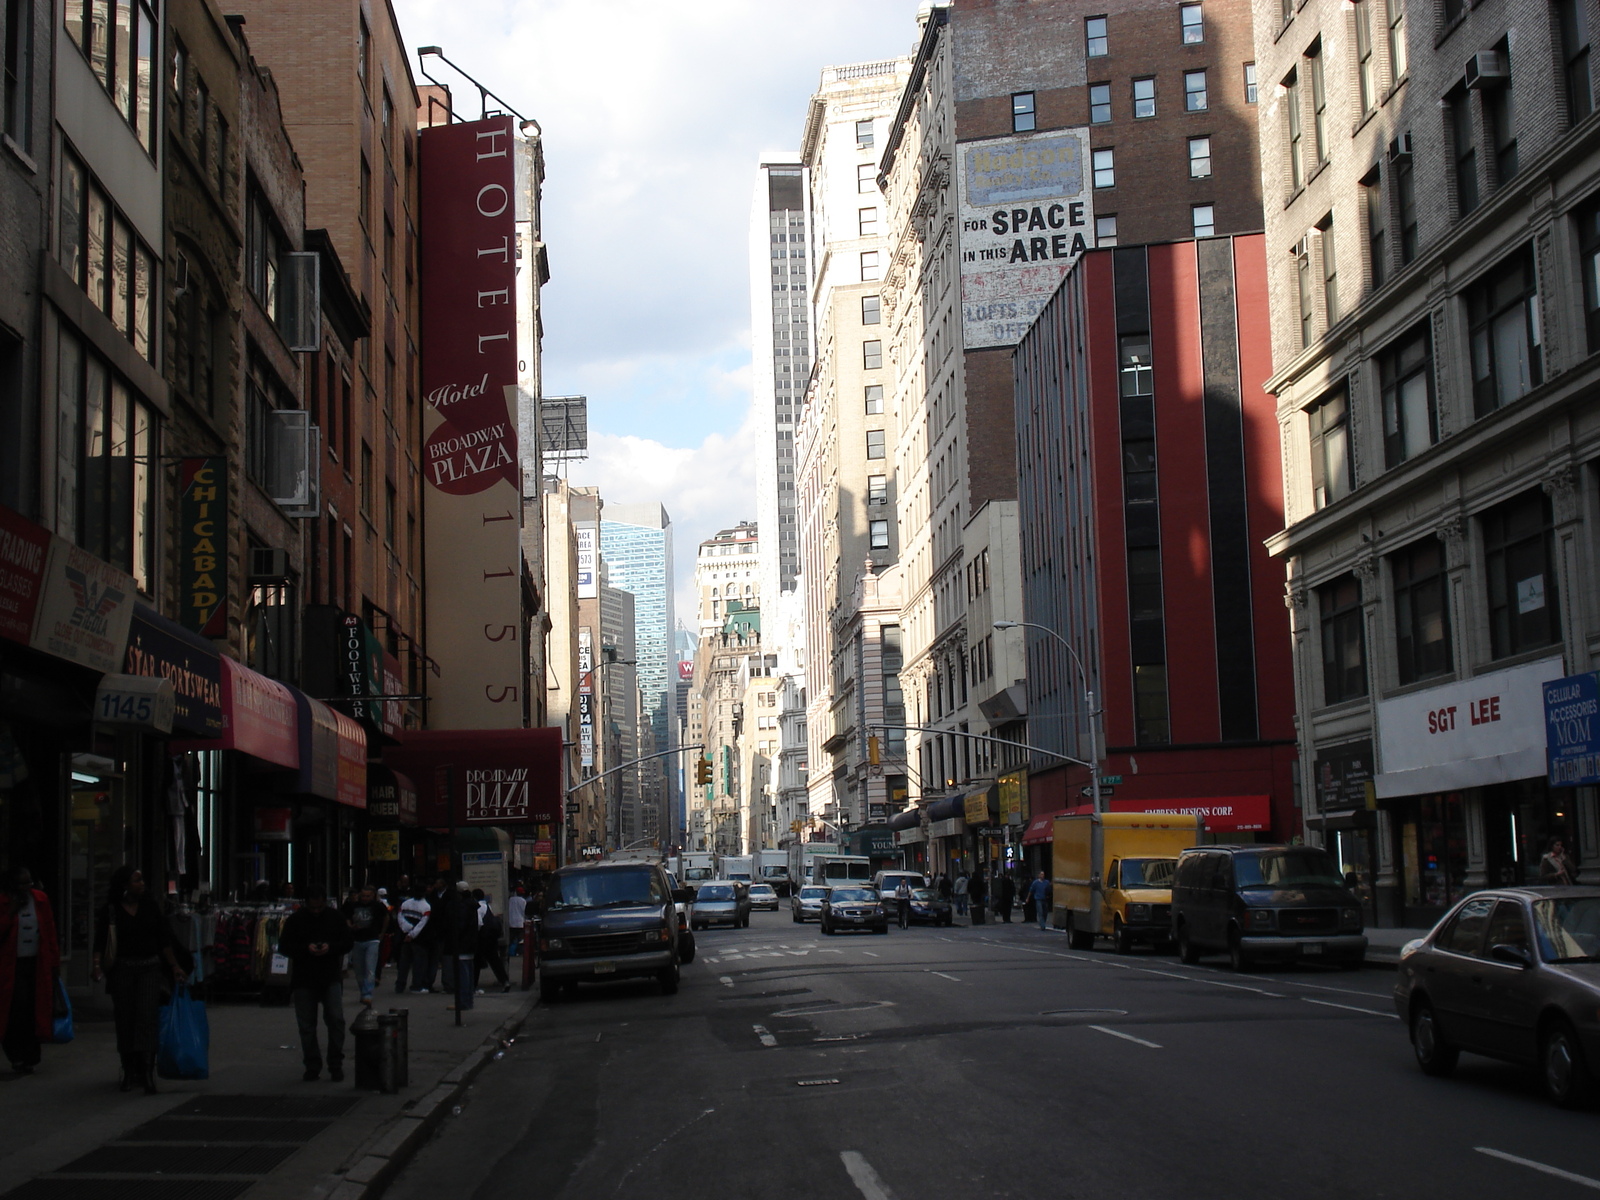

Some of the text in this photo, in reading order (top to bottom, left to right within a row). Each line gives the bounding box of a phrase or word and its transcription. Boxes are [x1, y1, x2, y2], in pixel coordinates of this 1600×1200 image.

[963, 202, 1085, 236] FOR SPACE
[476, 128, 509, 354] HOTEL
[963, 232, 1087, 264] IN THIS AREA
[966, 302, 1018, 322] LOFTS
[427, 373, 489, 411] Hotel
[429, 423, 506, 459] BROADWAY
[432, 442, 513, 486] PLAZA
[192, 467, 217, 625] CHICABADI
[482, 509, 518, 704] 1155
[127, 645, 156, 677] STAR
[160, 660, 221, 709] SPORTSWEAR
[683, 663, 694, 672] W
[101, 693, 152, 721] 1145
[1547, 684, 1581, 705] CELLULAR
[1428, 696, 1502, 735] SGT LEE
[1549, 699, 1598, 725] ACCESSORIES
[1555, 716, 1592, 747] MOM
[466, 768, 529, 783] BROADWAY
[371, 785, 395, 799] HAIR
[466, 781, 529, 809] PLAZA
[370, 802, 399, 816] QUEEN
[466, 808, 529, 817] HOTEL
[1212, 806, 1234, 816] CORP.
